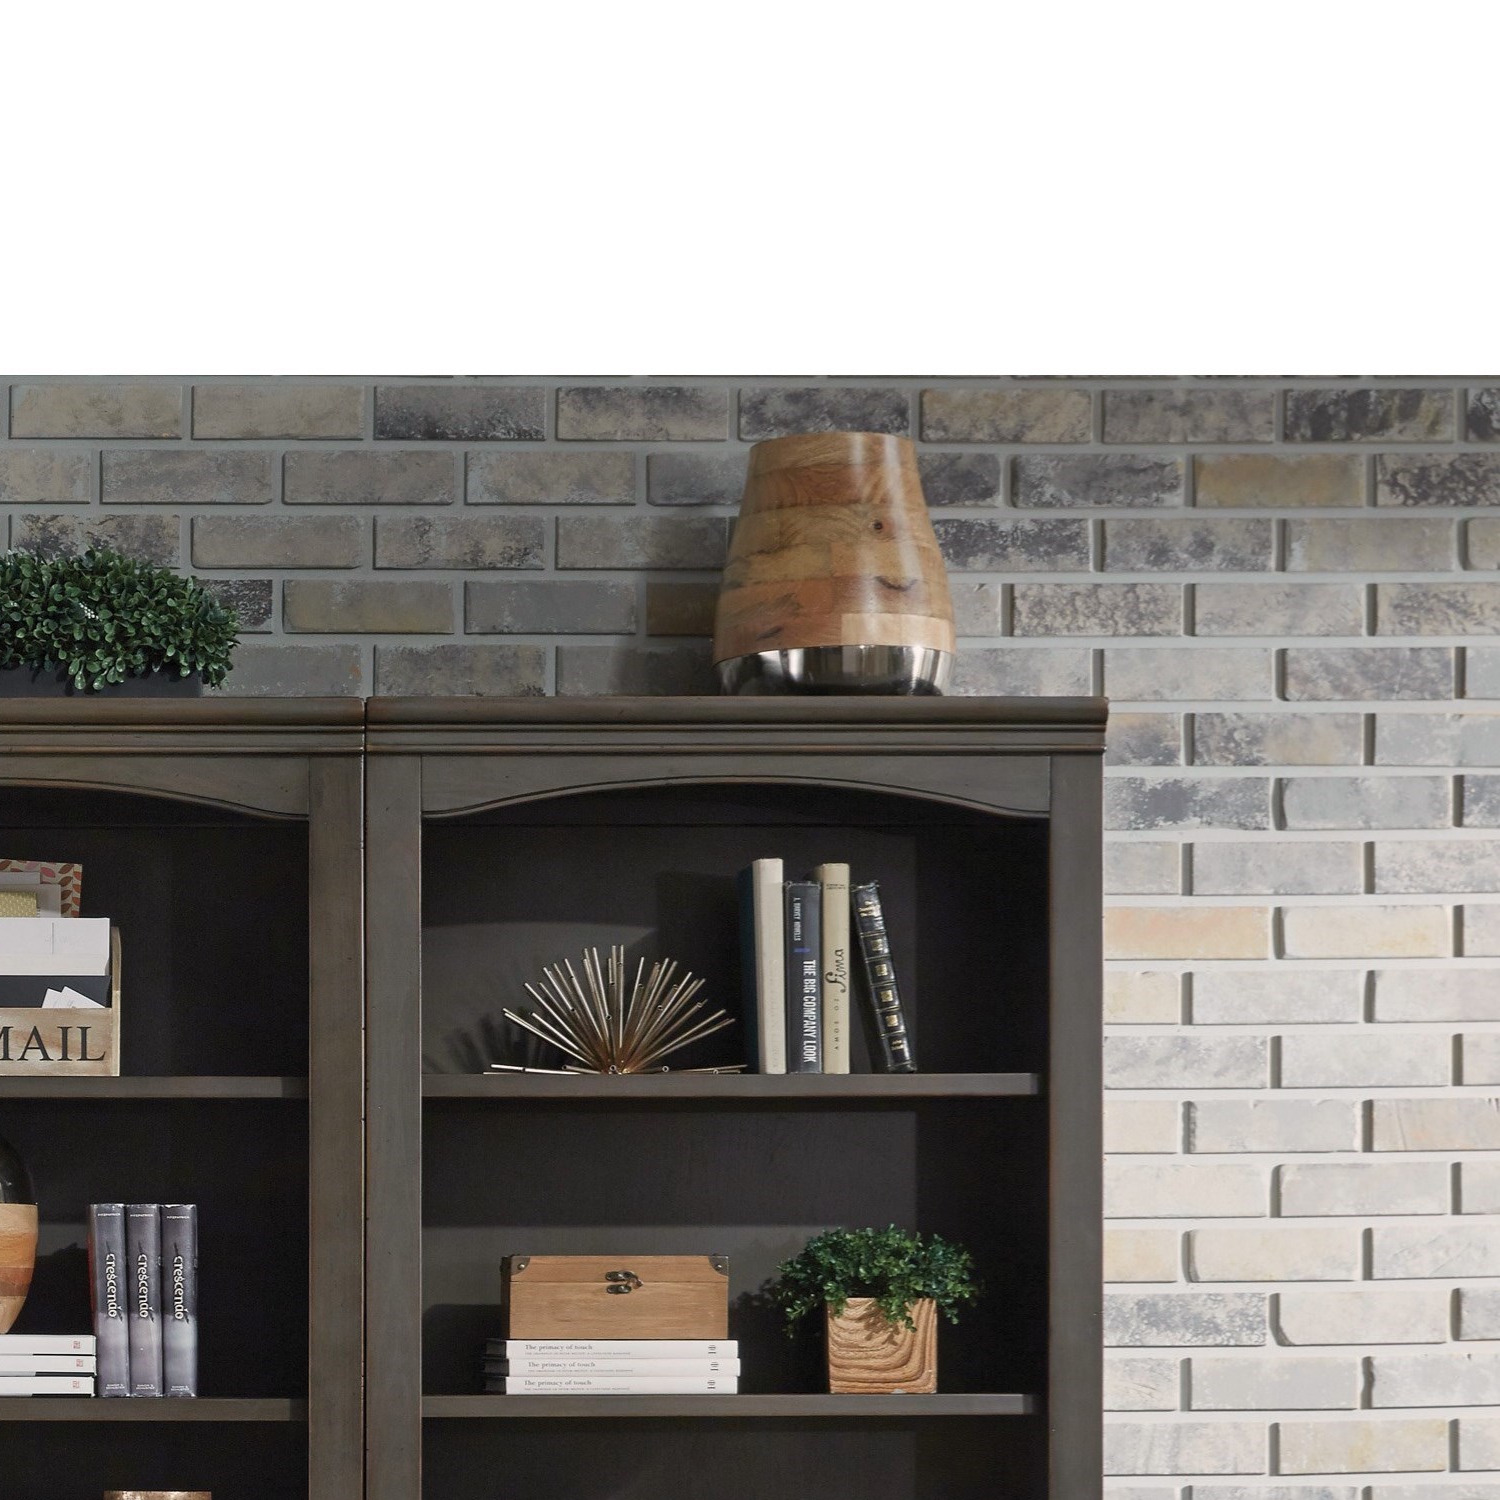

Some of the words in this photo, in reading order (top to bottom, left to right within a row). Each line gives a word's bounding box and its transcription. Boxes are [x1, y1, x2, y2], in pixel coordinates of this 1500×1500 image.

[803, 960, 817, 976] THE
[803, 978, 817, 993] BIG
[803, 995, 817, 1038] COMPANY
[803, 1040, 817, 1063] LOOK
[106, 1254, 122, 1318] crescendo
[138, 1254, 154, 1318] crescendo
[174, 1256, 189, 1320] crescendo
